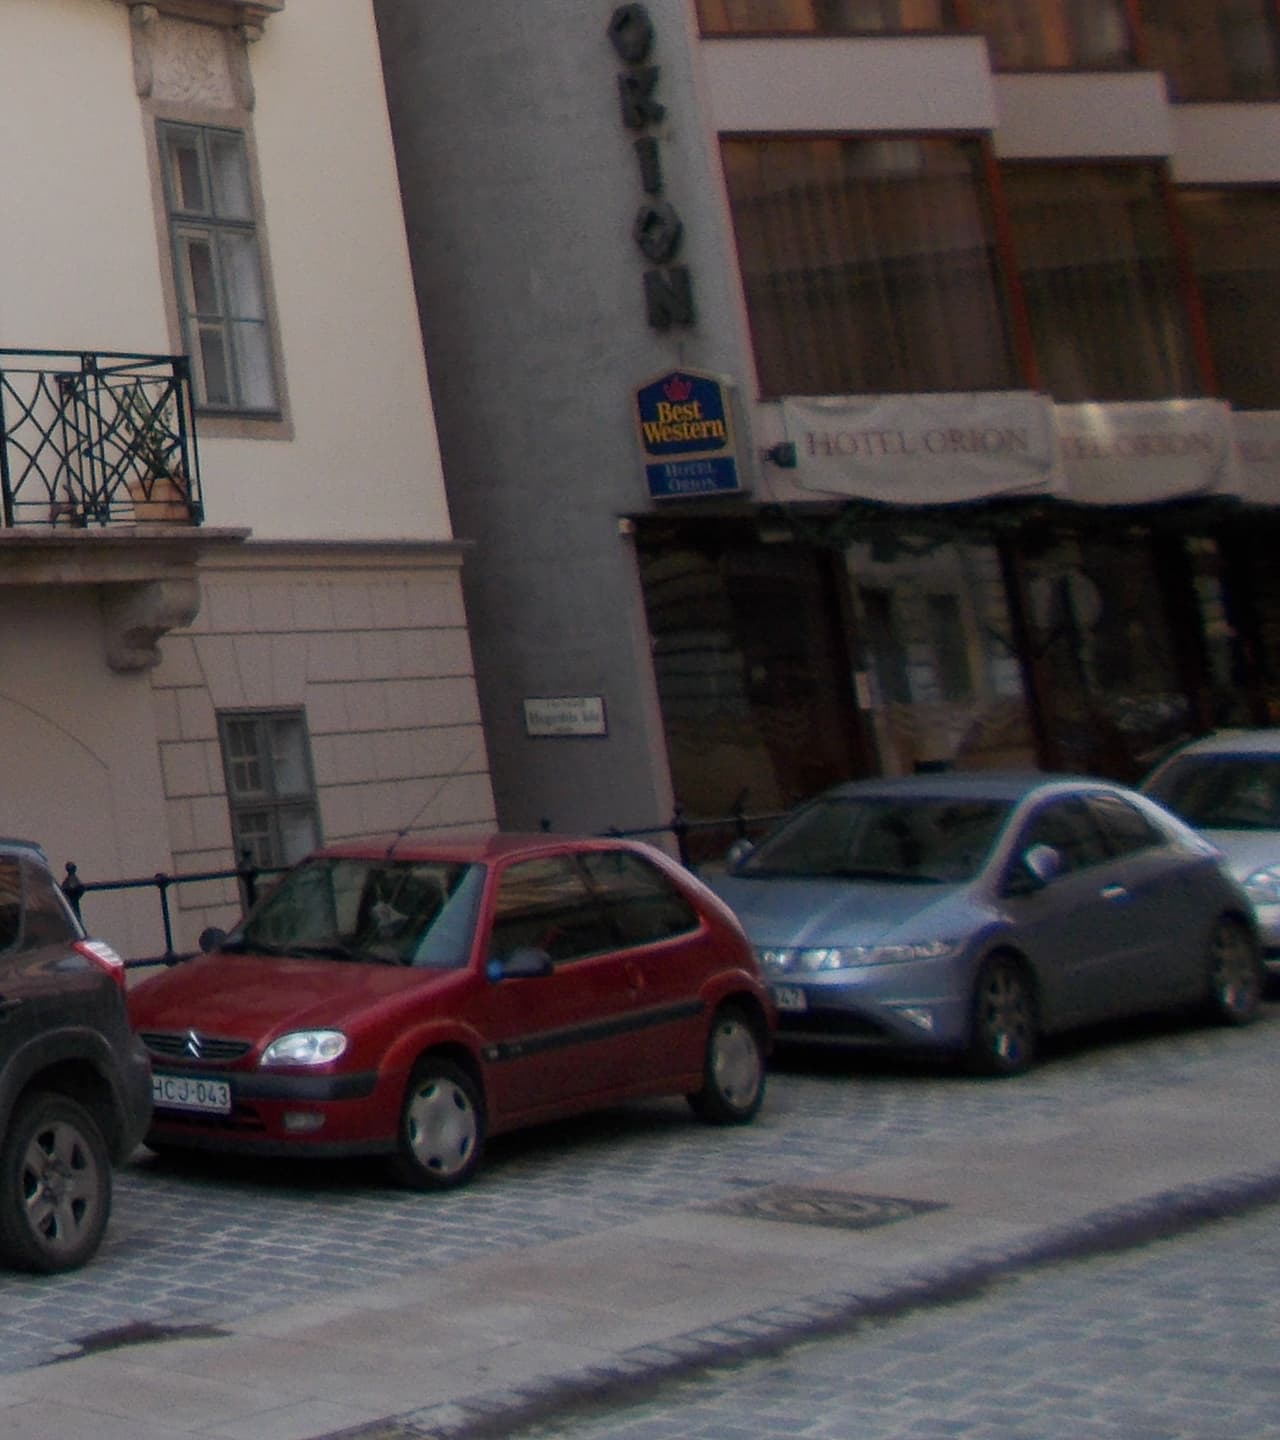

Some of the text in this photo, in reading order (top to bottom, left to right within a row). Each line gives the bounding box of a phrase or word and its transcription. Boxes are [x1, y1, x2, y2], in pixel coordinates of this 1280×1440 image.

[607, 0, 698, 335] ORION
[656, 400, 703, 422] Best
[642, 419, 726, 444] Western
[804, 426, 1029, 458] HOTEL ORION
